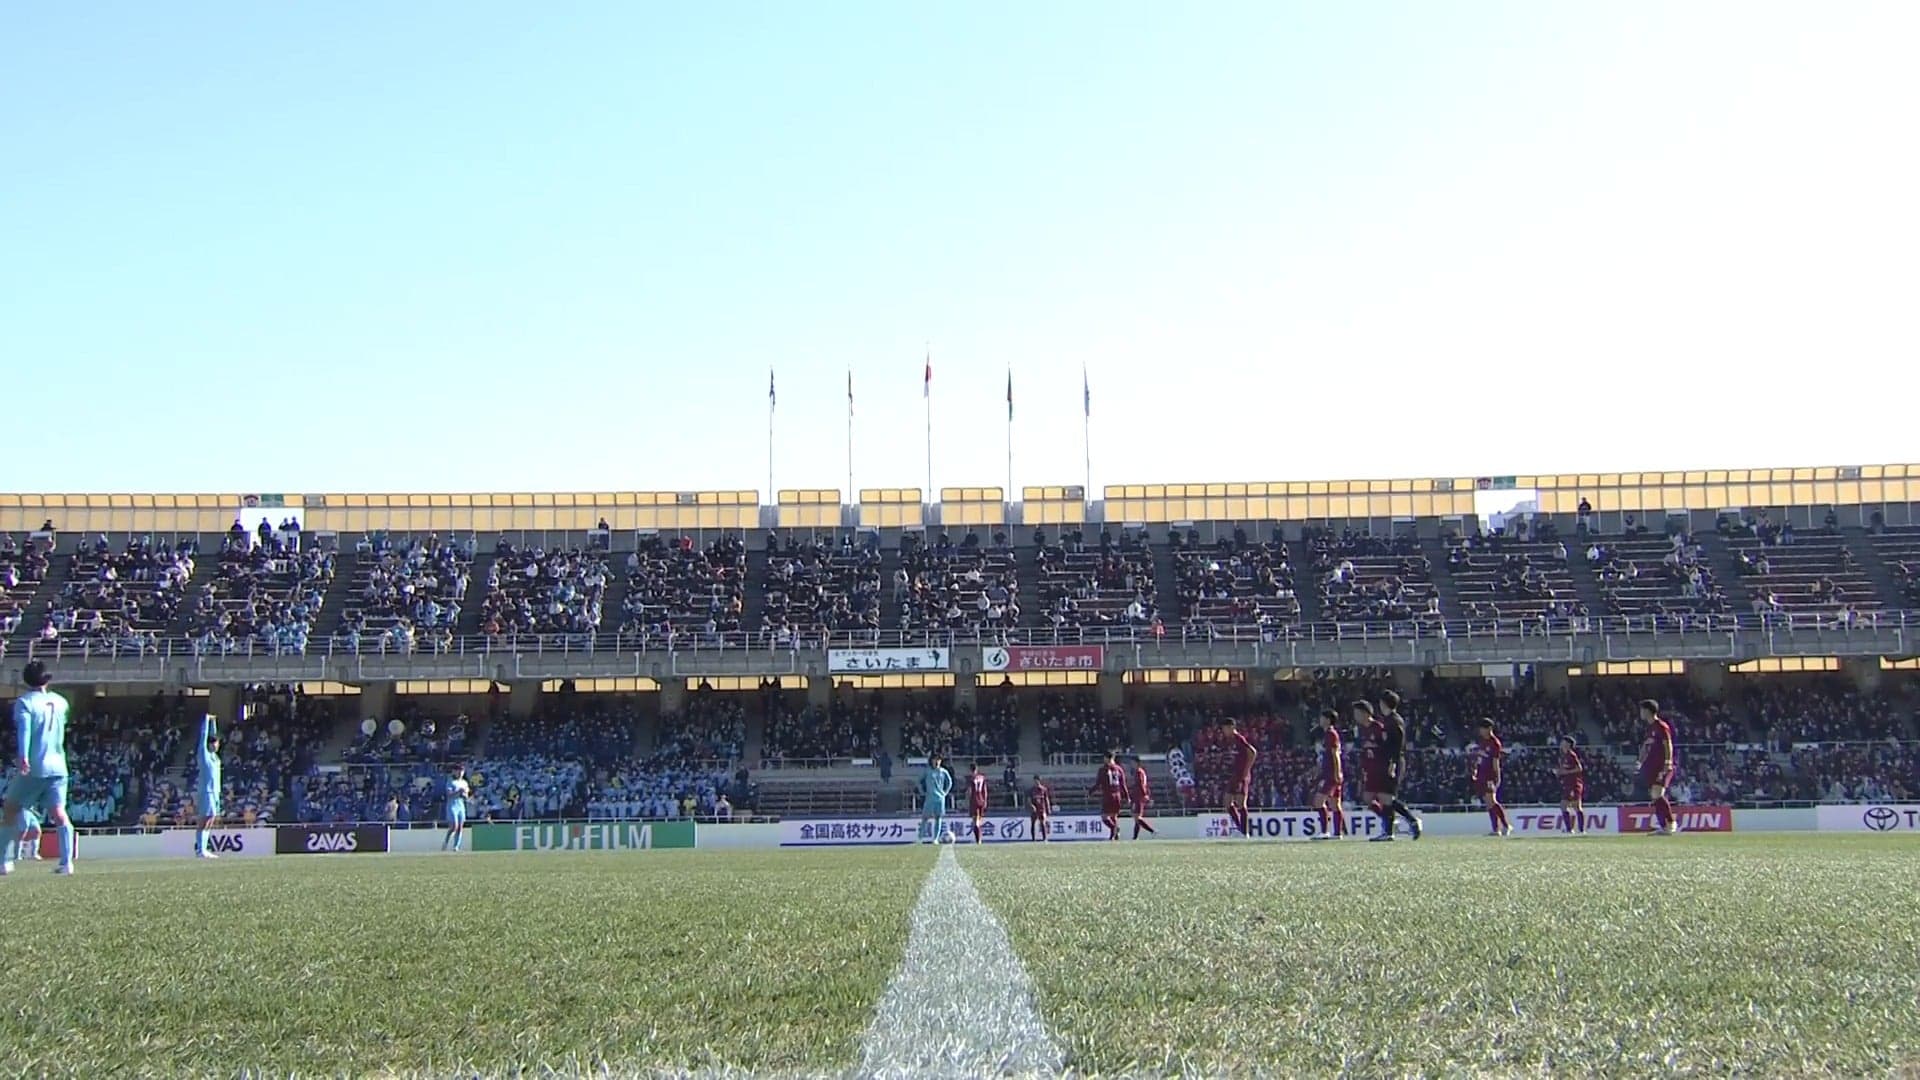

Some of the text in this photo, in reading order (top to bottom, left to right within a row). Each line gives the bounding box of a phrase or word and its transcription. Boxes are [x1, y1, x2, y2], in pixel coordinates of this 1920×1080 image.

[845, 656, 921, 668] さいたま
[1019, 655, 1093, 668] さいたま市
[45, 701, 55, 732] 7
[1248, 816, 1377, 837] HOT SFF
[1516, 813, 1608, 831] TEIN
[1628, 812, 1722, 833] TJIN
[1903, 809, 1920, 829] T
[195, 833, 244, 853] AVAS
[307, 832, 358, 851] SAVAS
